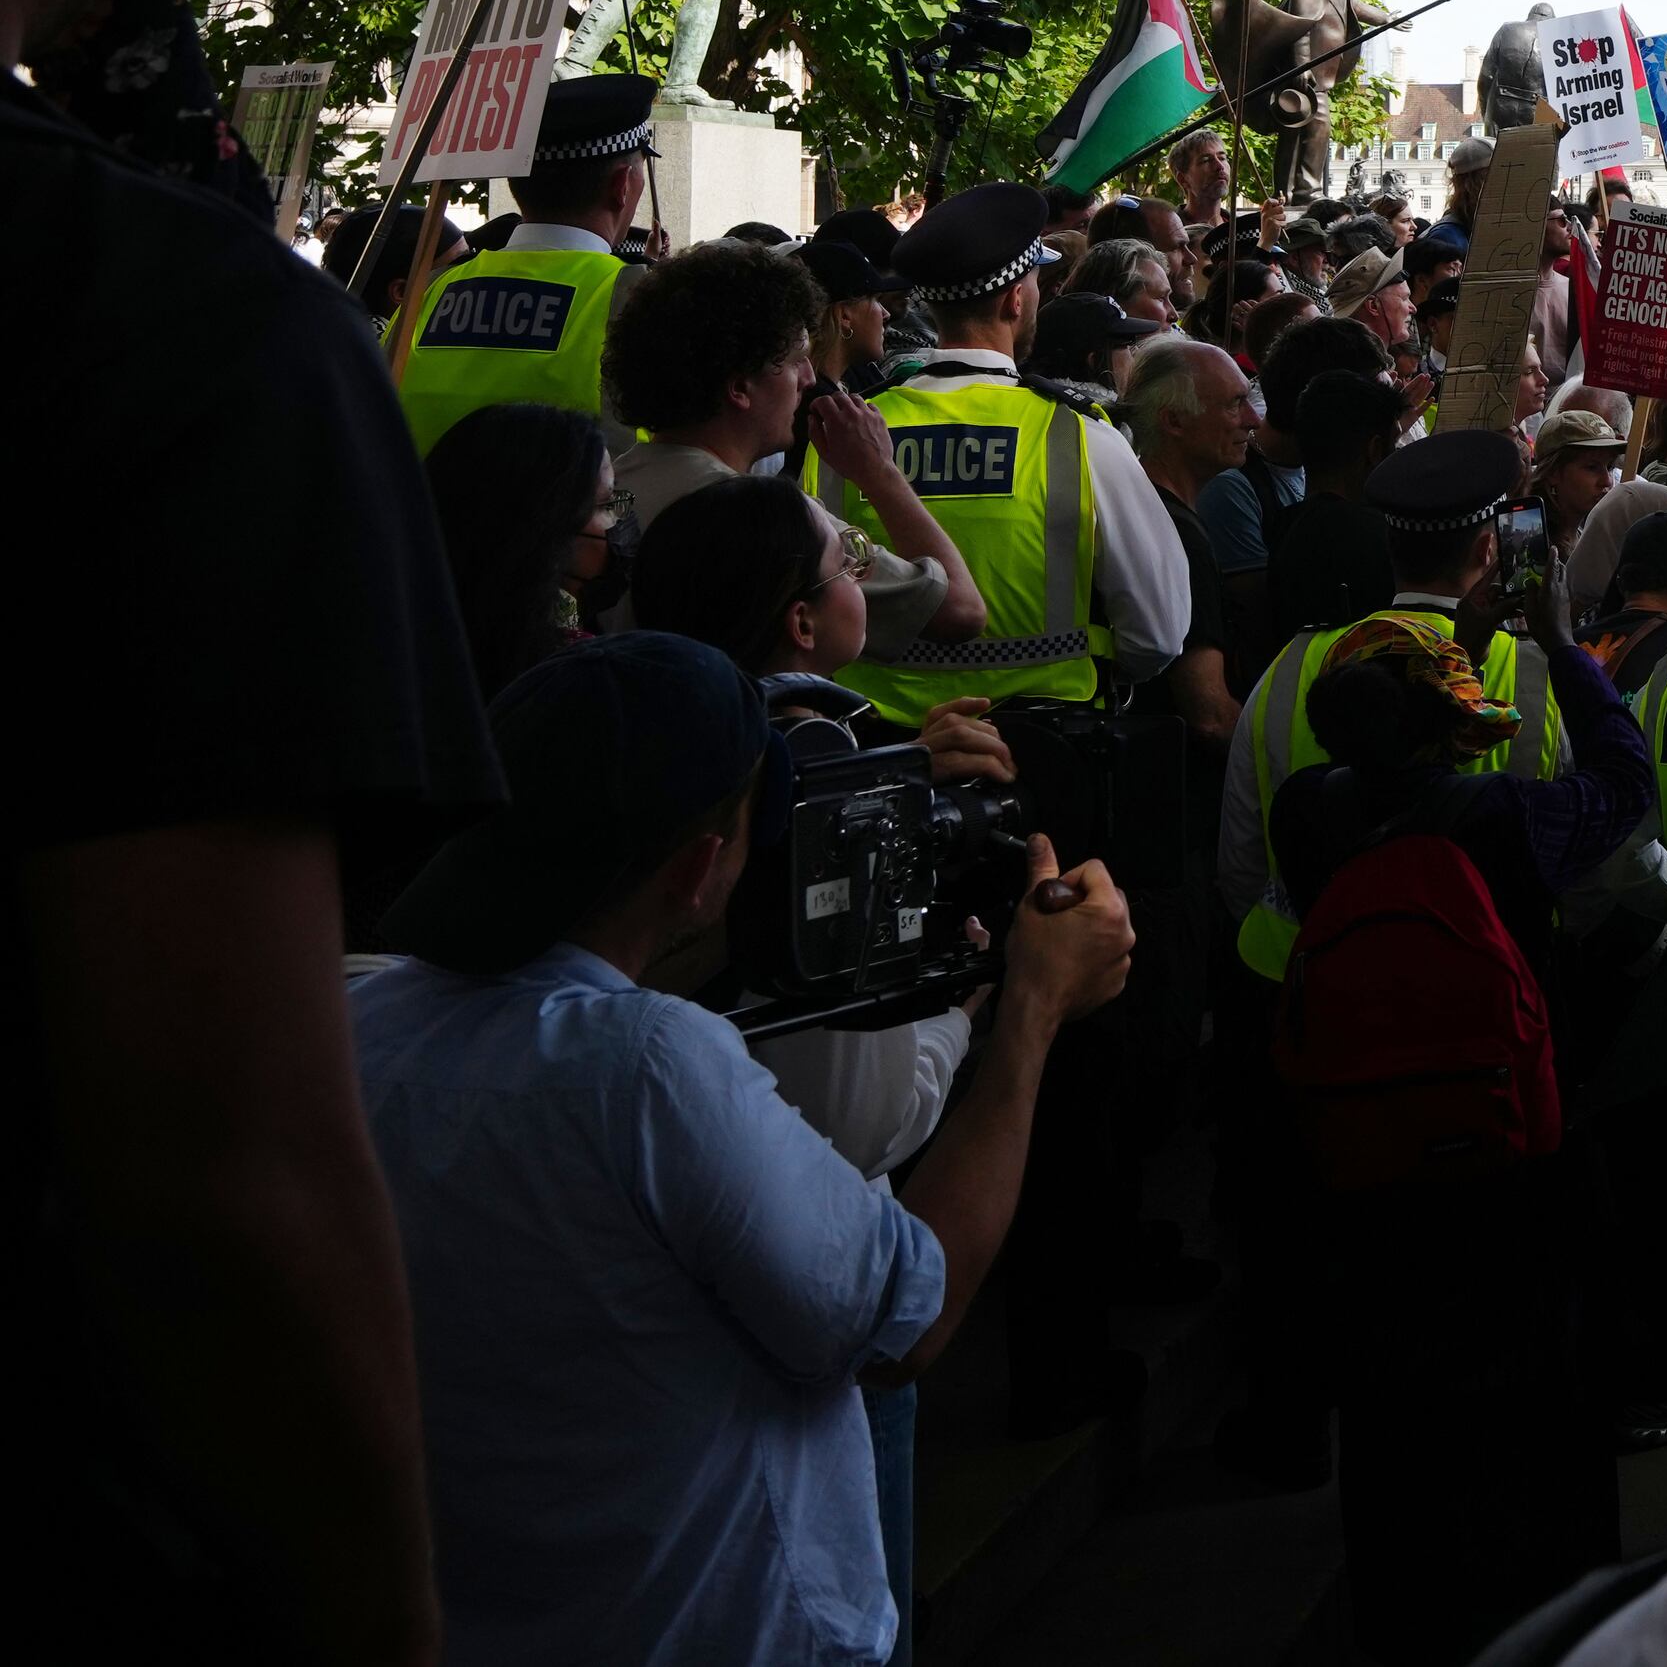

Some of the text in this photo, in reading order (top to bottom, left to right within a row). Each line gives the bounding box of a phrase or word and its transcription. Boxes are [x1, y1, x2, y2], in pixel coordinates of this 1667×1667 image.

[1556, 69, 1624, 98] Arming
[1562, 92, 1625, 126] Israel
[1607, 273, 1643, 298] ACT
[429, 290, 562, 338] POLICE
[1607, 327, 1629, 343] Free
[1604, 342, 1638, 359] Defend
[1640, 364, 1661, 380] fight
[896, 437, 1008, 483] OLICE
